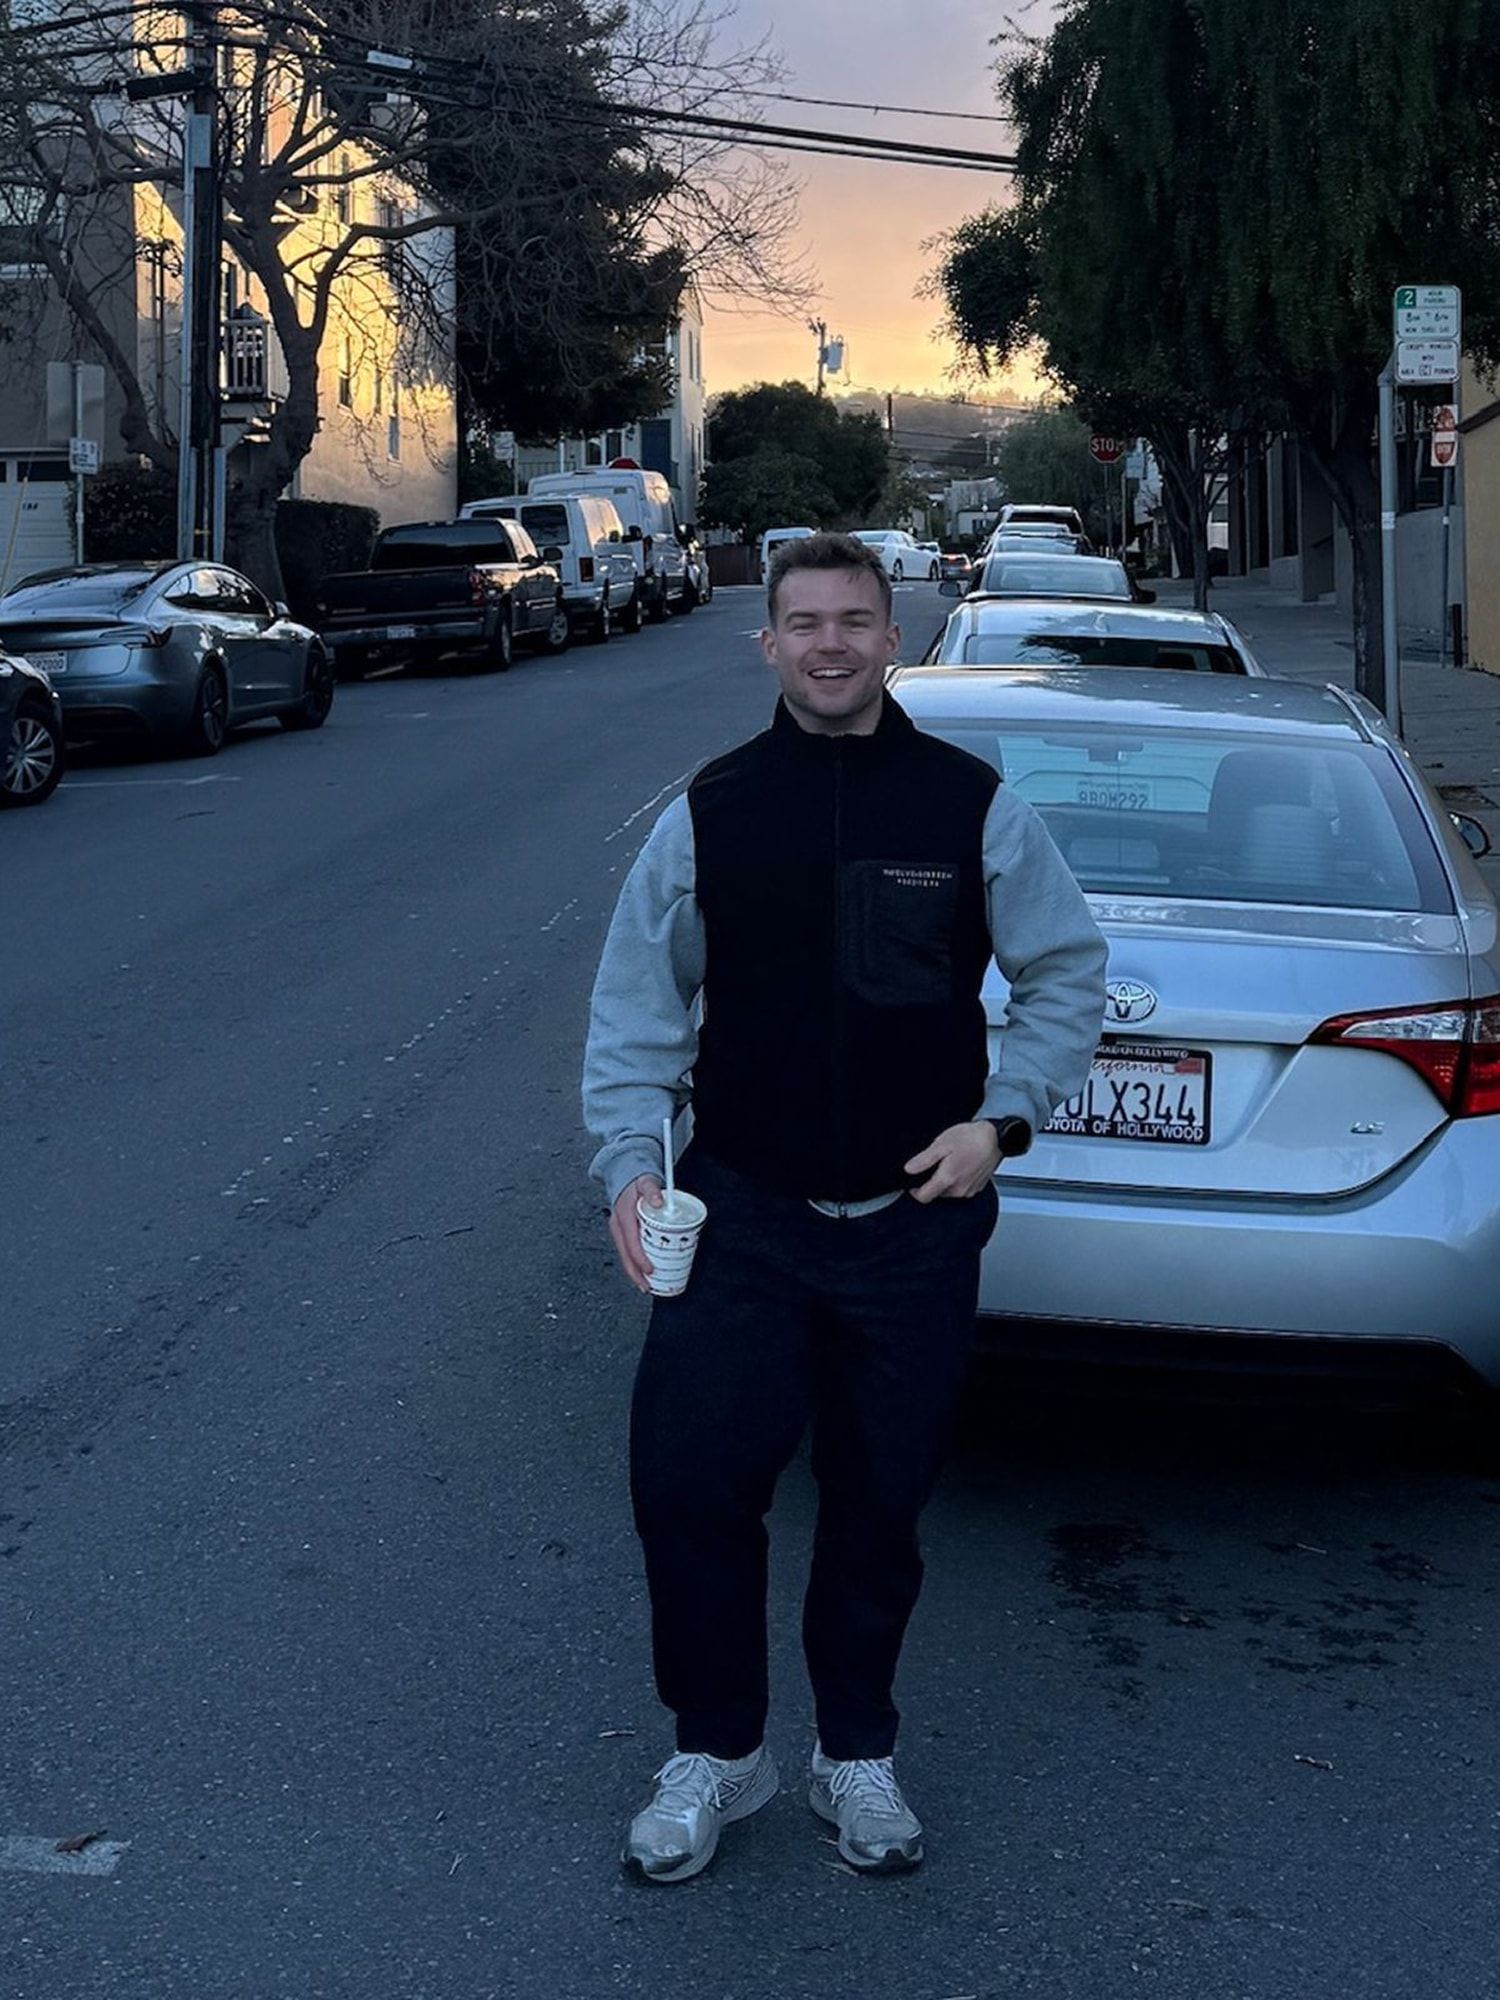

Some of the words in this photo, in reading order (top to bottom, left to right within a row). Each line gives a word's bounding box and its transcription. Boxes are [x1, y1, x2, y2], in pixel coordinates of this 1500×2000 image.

[1404, 290, 1414, 305] 2
[1092, 1120, 1112, 1134] OF
[1117, 1121, 1204, 1141] HOLLYWOOD
